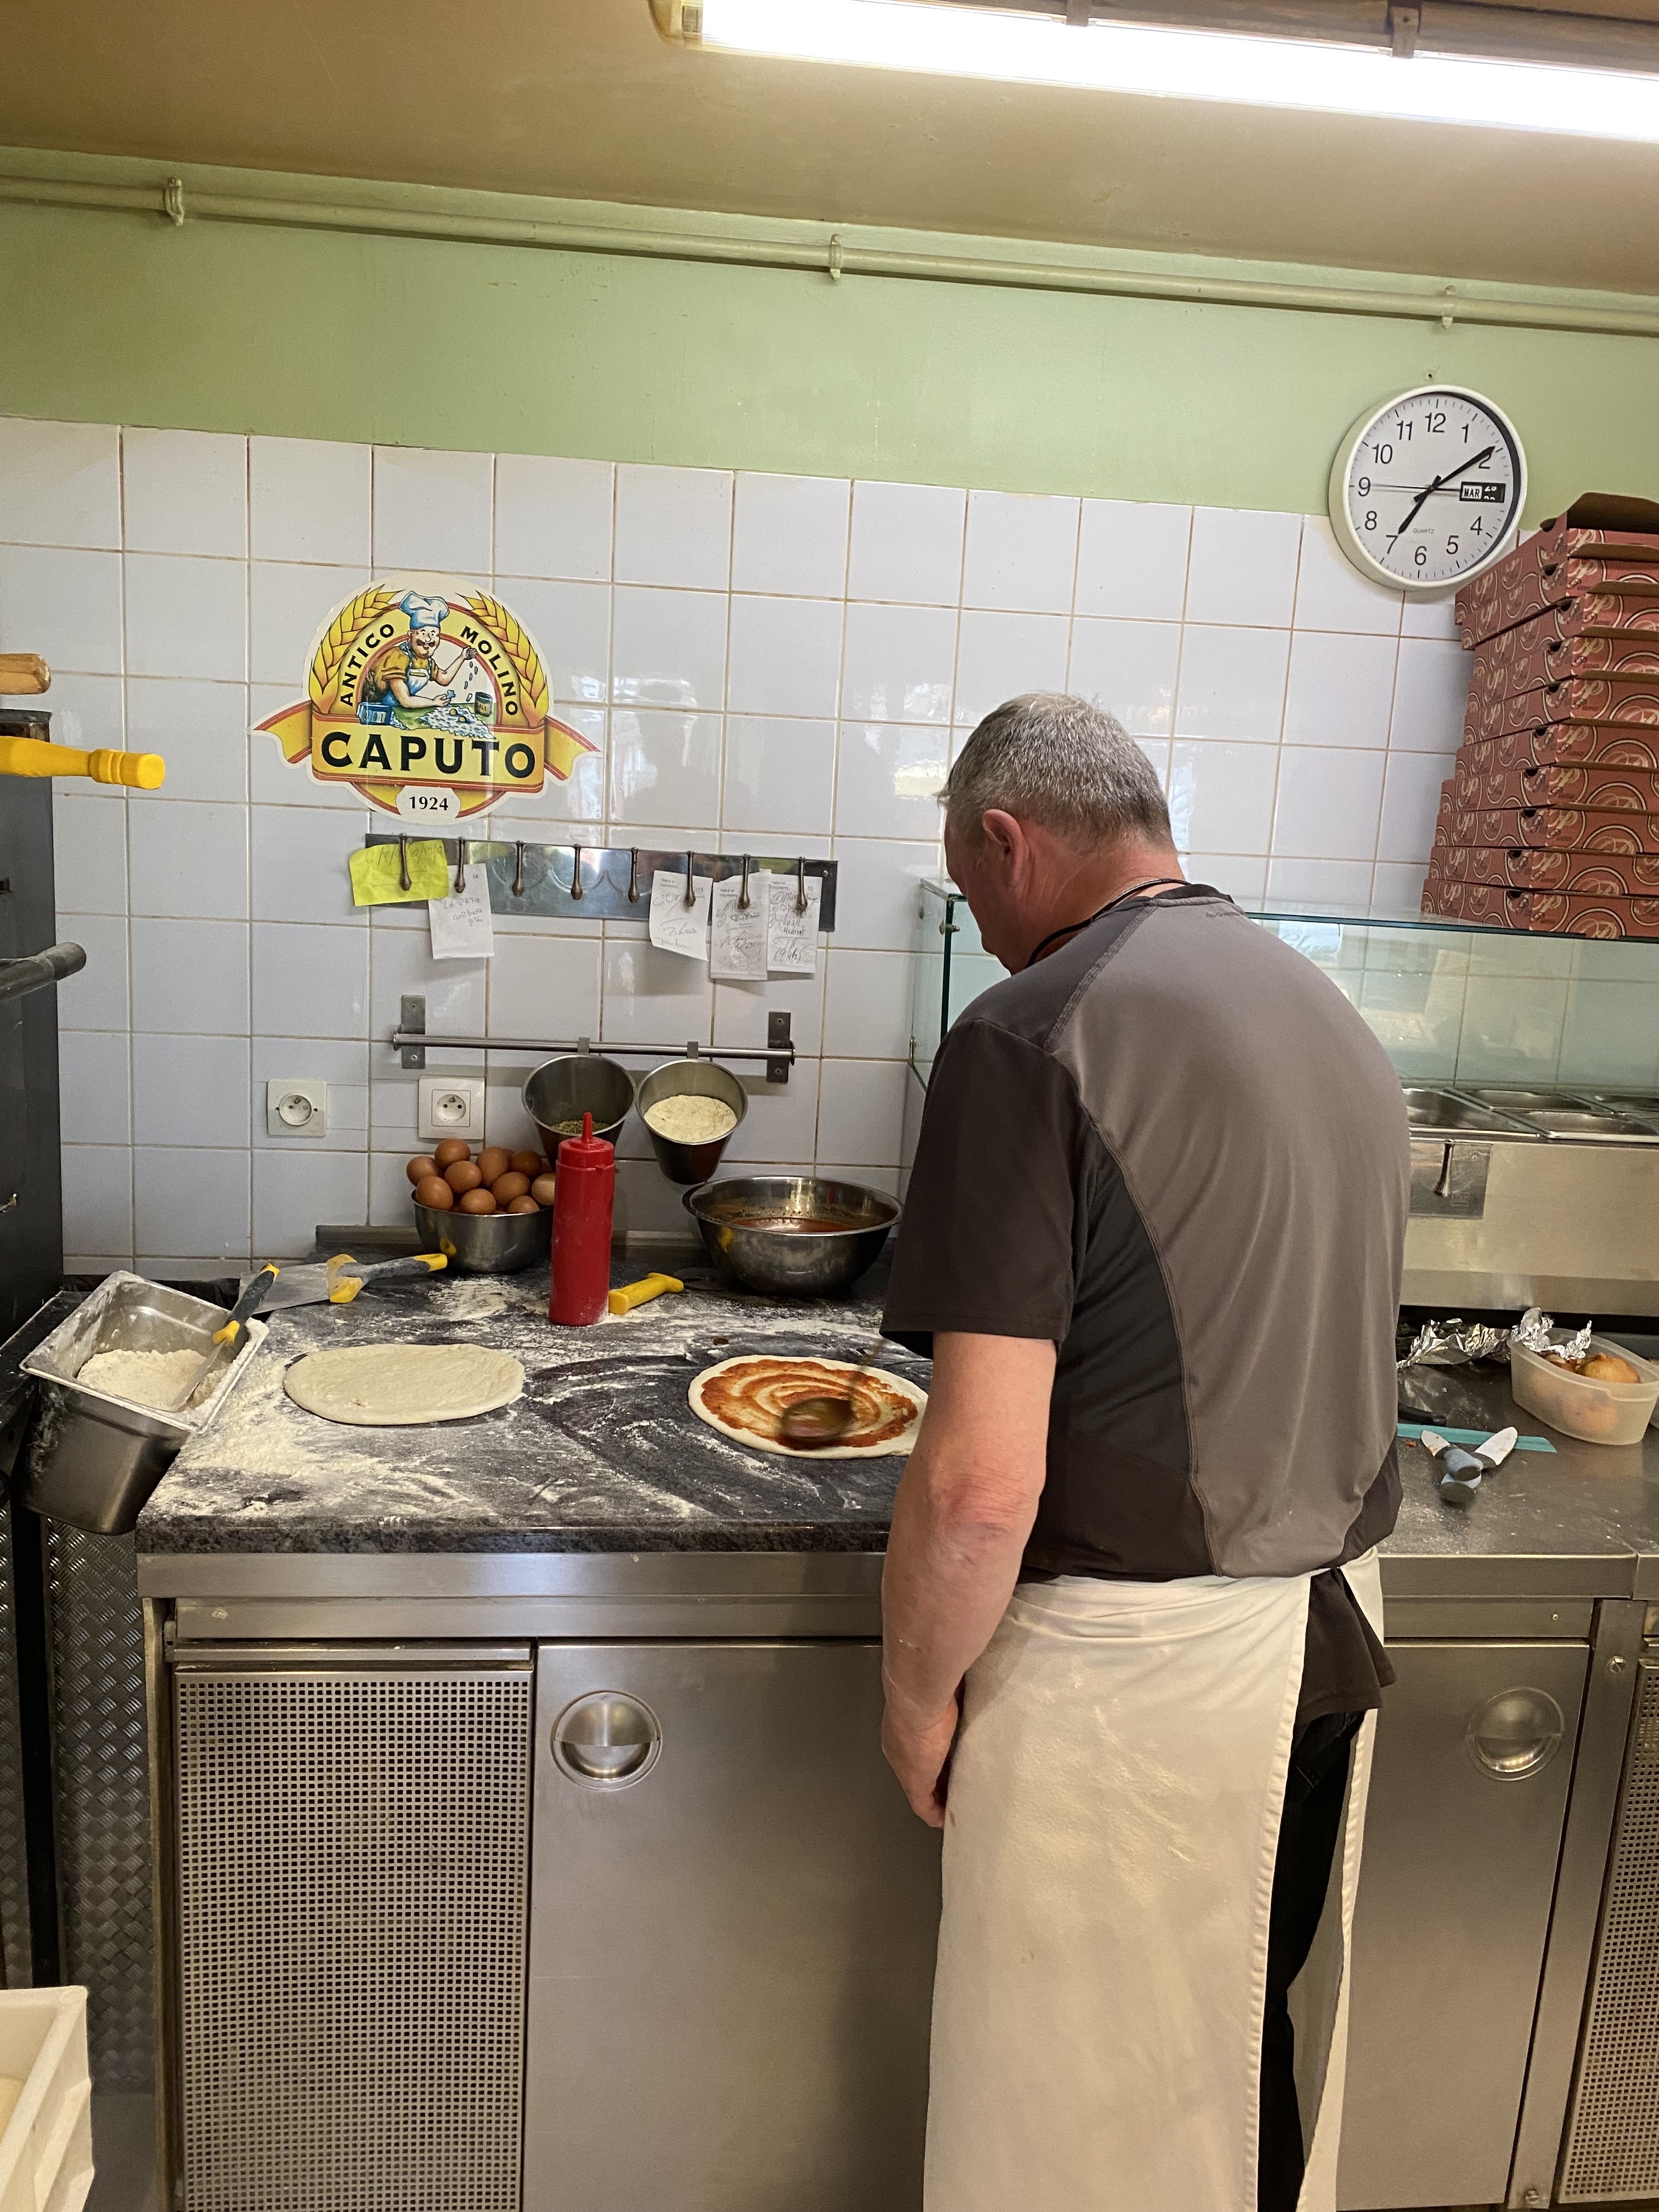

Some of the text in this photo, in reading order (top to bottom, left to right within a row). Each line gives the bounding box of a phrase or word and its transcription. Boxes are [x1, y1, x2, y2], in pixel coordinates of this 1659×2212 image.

[1396, 420, 1413, 441] 11
[1425, 413, 1446, 433] 12
[1462, 424, 1470, 443] 1
[1372, 443, 1393, 464] 10
[1478, 452, 1492, 469] 2
[1358, 476, 1371, 497] 9
[1464, 488, 1480, 498] MAR
[1364, 511, 1378, 531] 8
[1470, 516, 1483, 535] 4
[1386, 534, 1398, 554] 7
[1446, 535, 1459, 555] 5
[1414, 546, 1427, 565] 6
[340, 623, 518, 716] ANTICO MOLINO
[321, 730, 535, 778] CAPUTO
[409, 795, 449, 812] 1924
